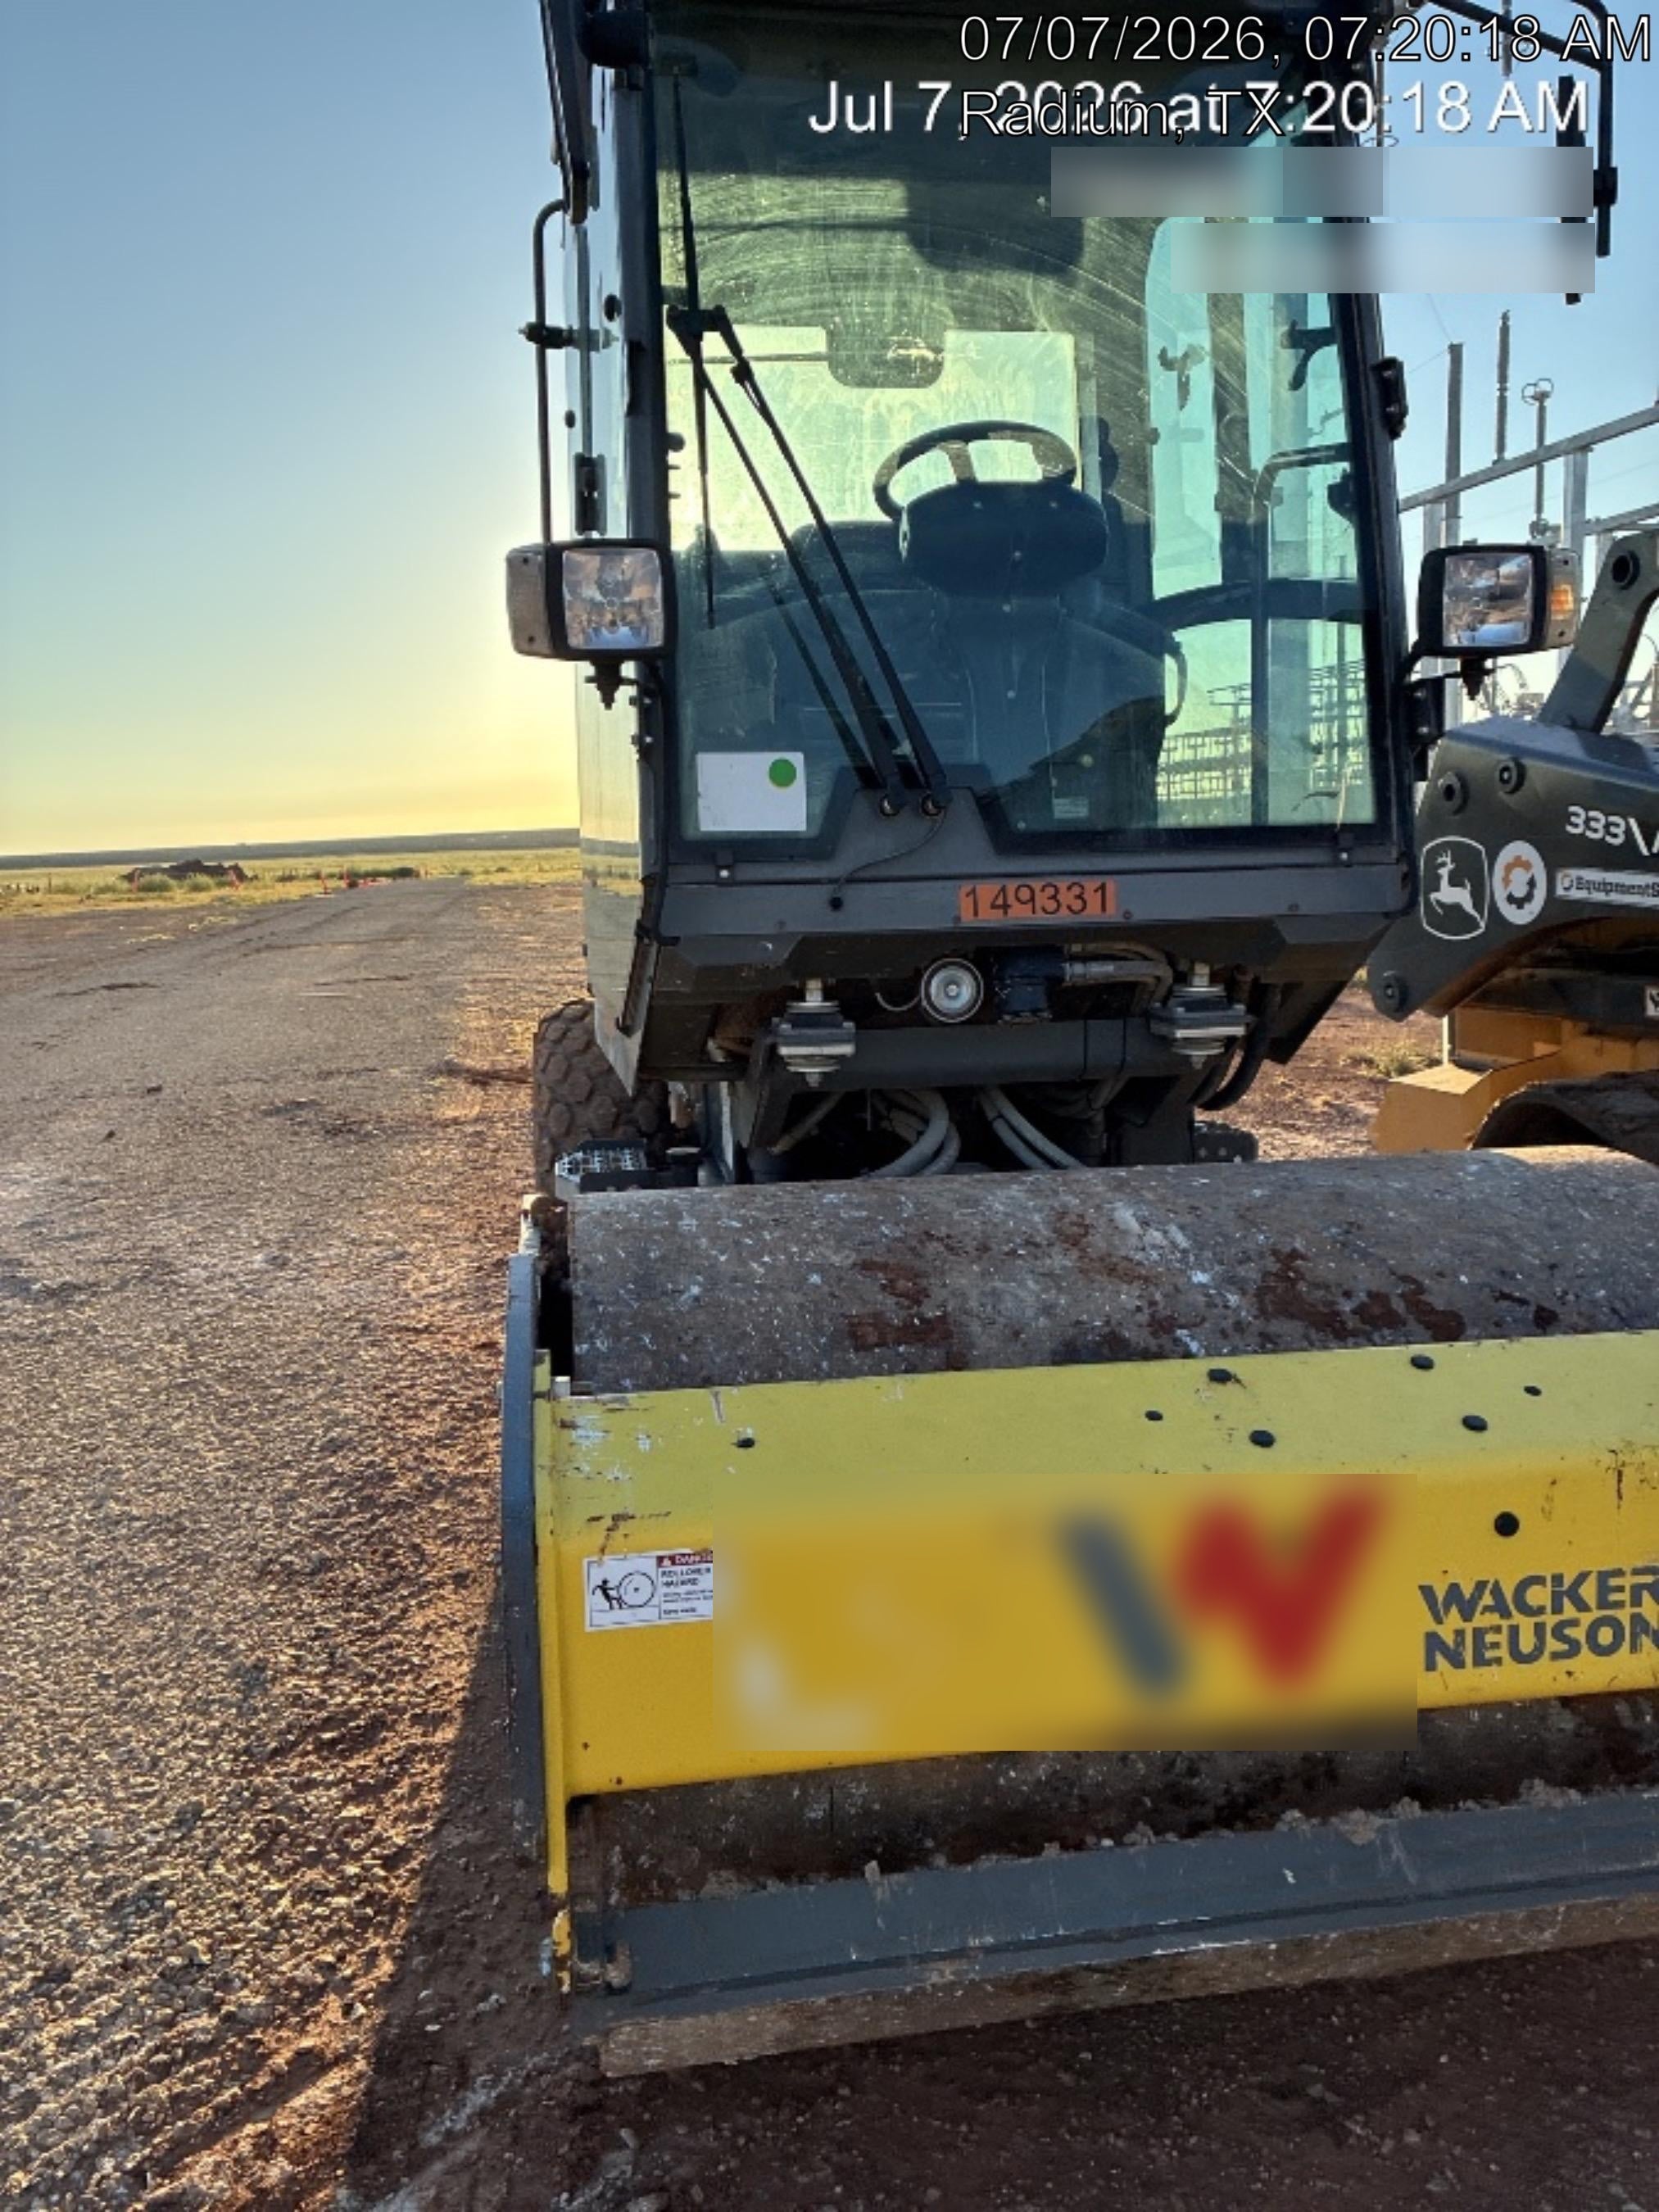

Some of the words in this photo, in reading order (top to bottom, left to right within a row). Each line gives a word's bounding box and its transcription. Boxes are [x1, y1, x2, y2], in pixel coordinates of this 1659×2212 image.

[965, 881, 1108, 918] 149331
[1417, 1565, 1659, 1625] WACKER
[1423, 1611, 1659, 1672] NEUSON
